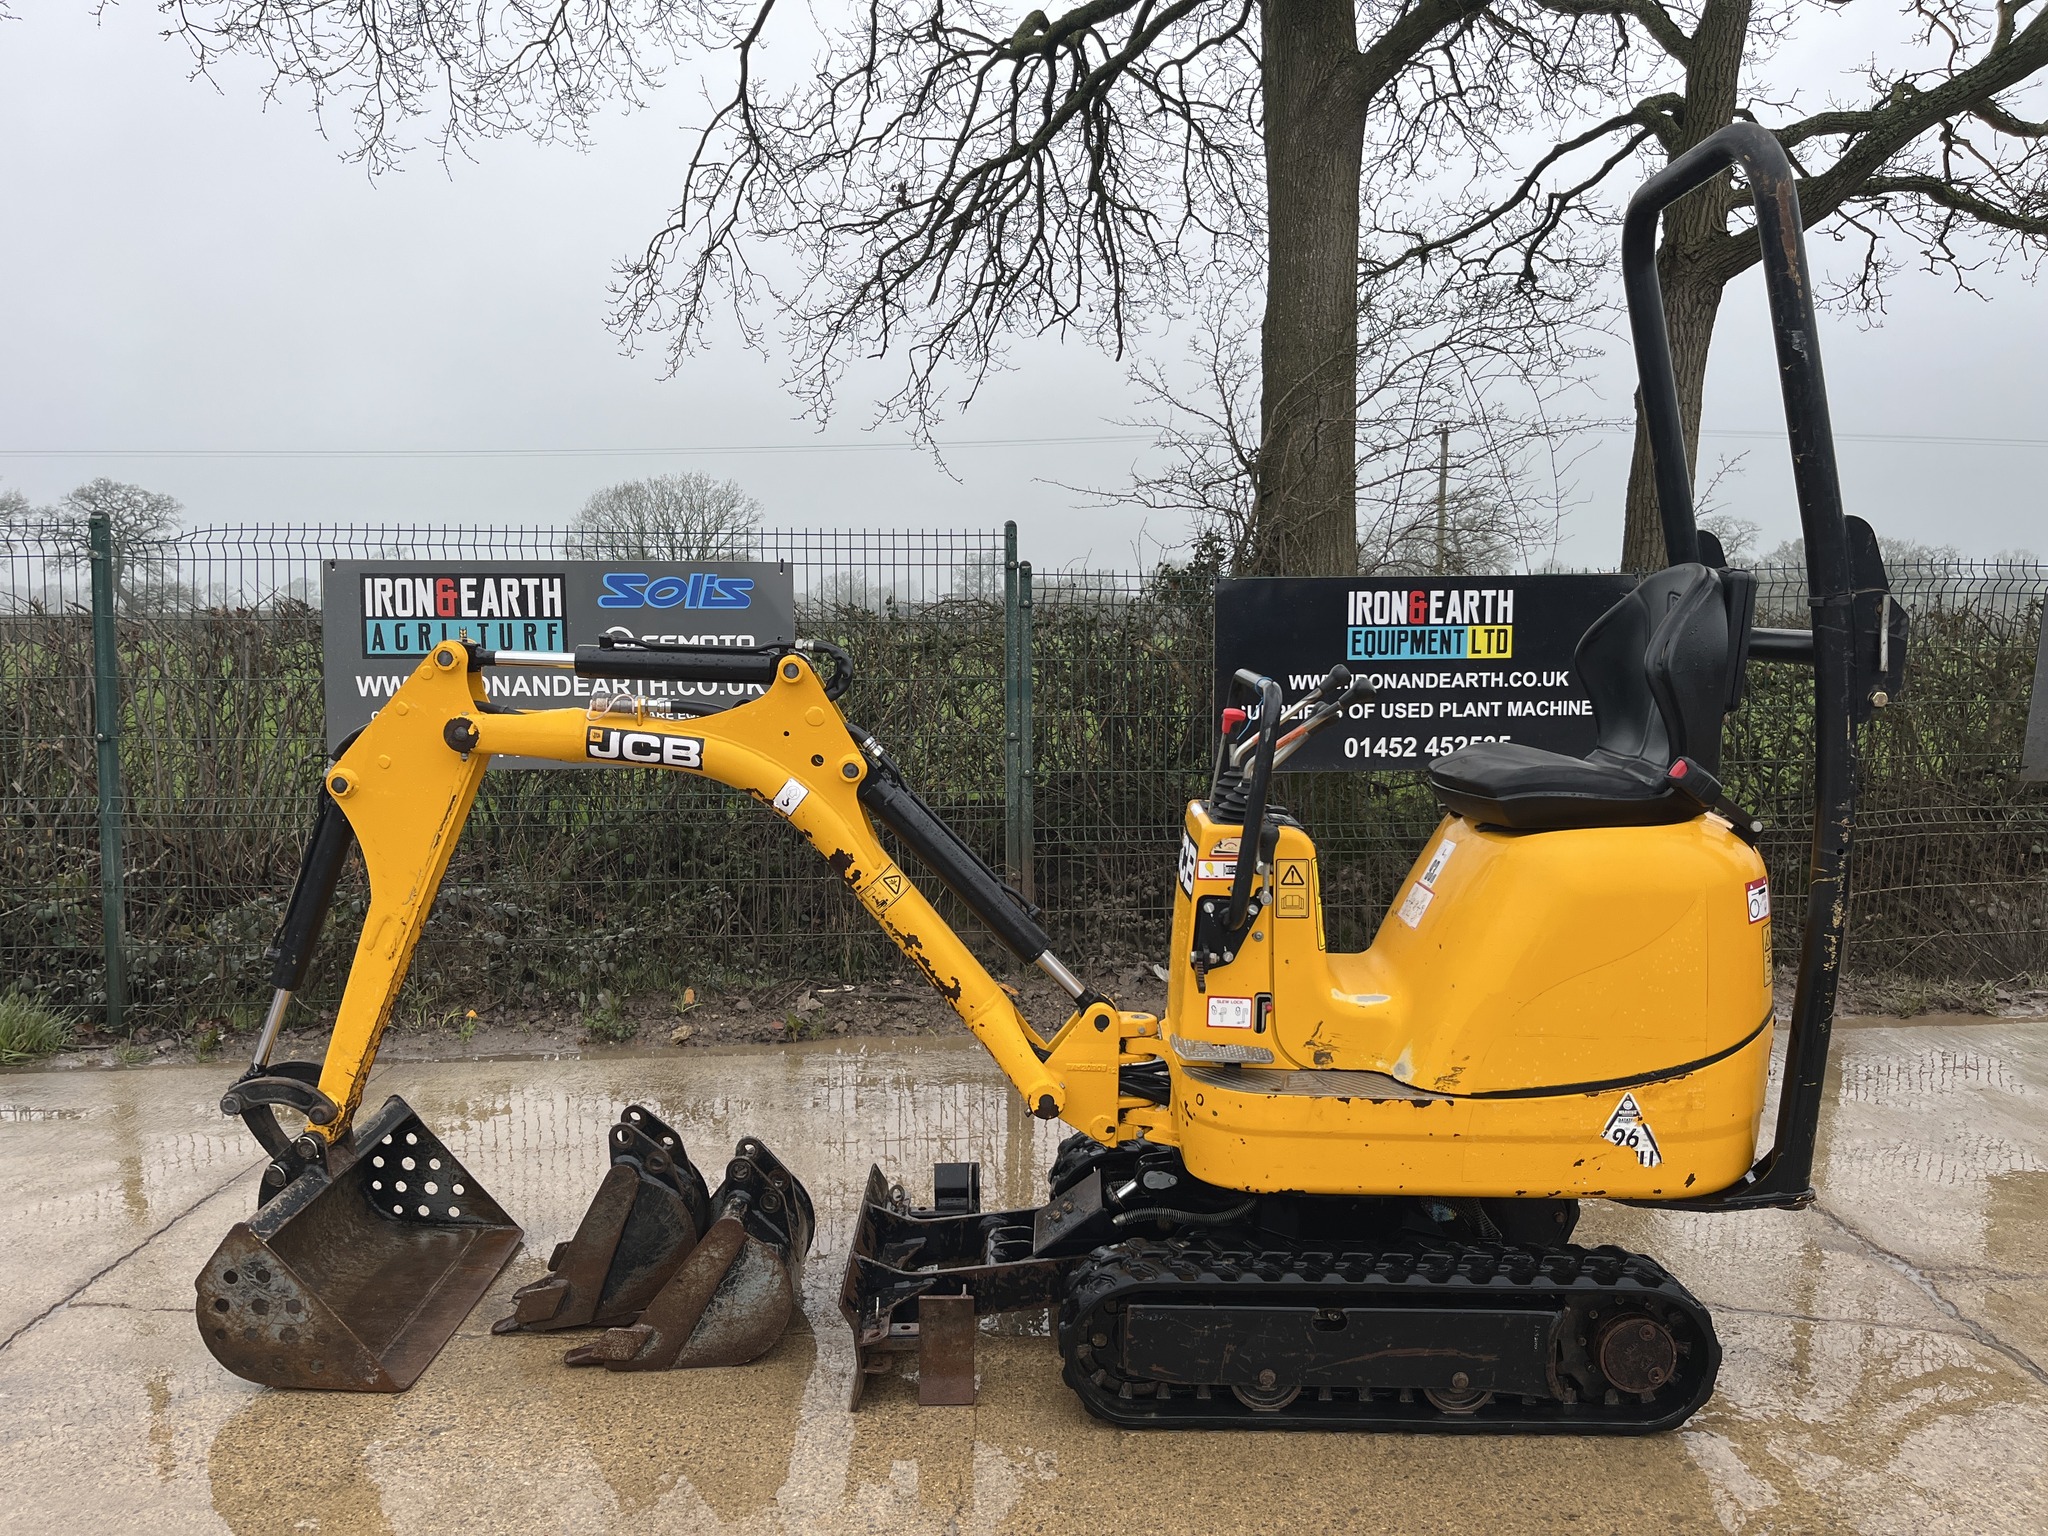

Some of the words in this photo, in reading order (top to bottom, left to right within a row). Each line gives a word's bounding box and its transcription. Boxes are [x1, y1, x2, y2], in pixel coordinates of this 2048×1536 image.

[364, 577, 563, 617] IRON&EARTH
[1347, 589, 1514, 625] IRON&EARTH
[1351, 629, 1465, 658] EQUIPMENT
[1471, 628, 1508, 654] LTD
[1348, 703, 1376, 719] OF
[1381, 702, 1434, 719] USED
[1439, 701, 1503, 718] PLANT
[589, 731, 701, 768] JCB
[1344, 736, 1418, 758] 01452
[1612, 1127, 1640, 1148] 96
